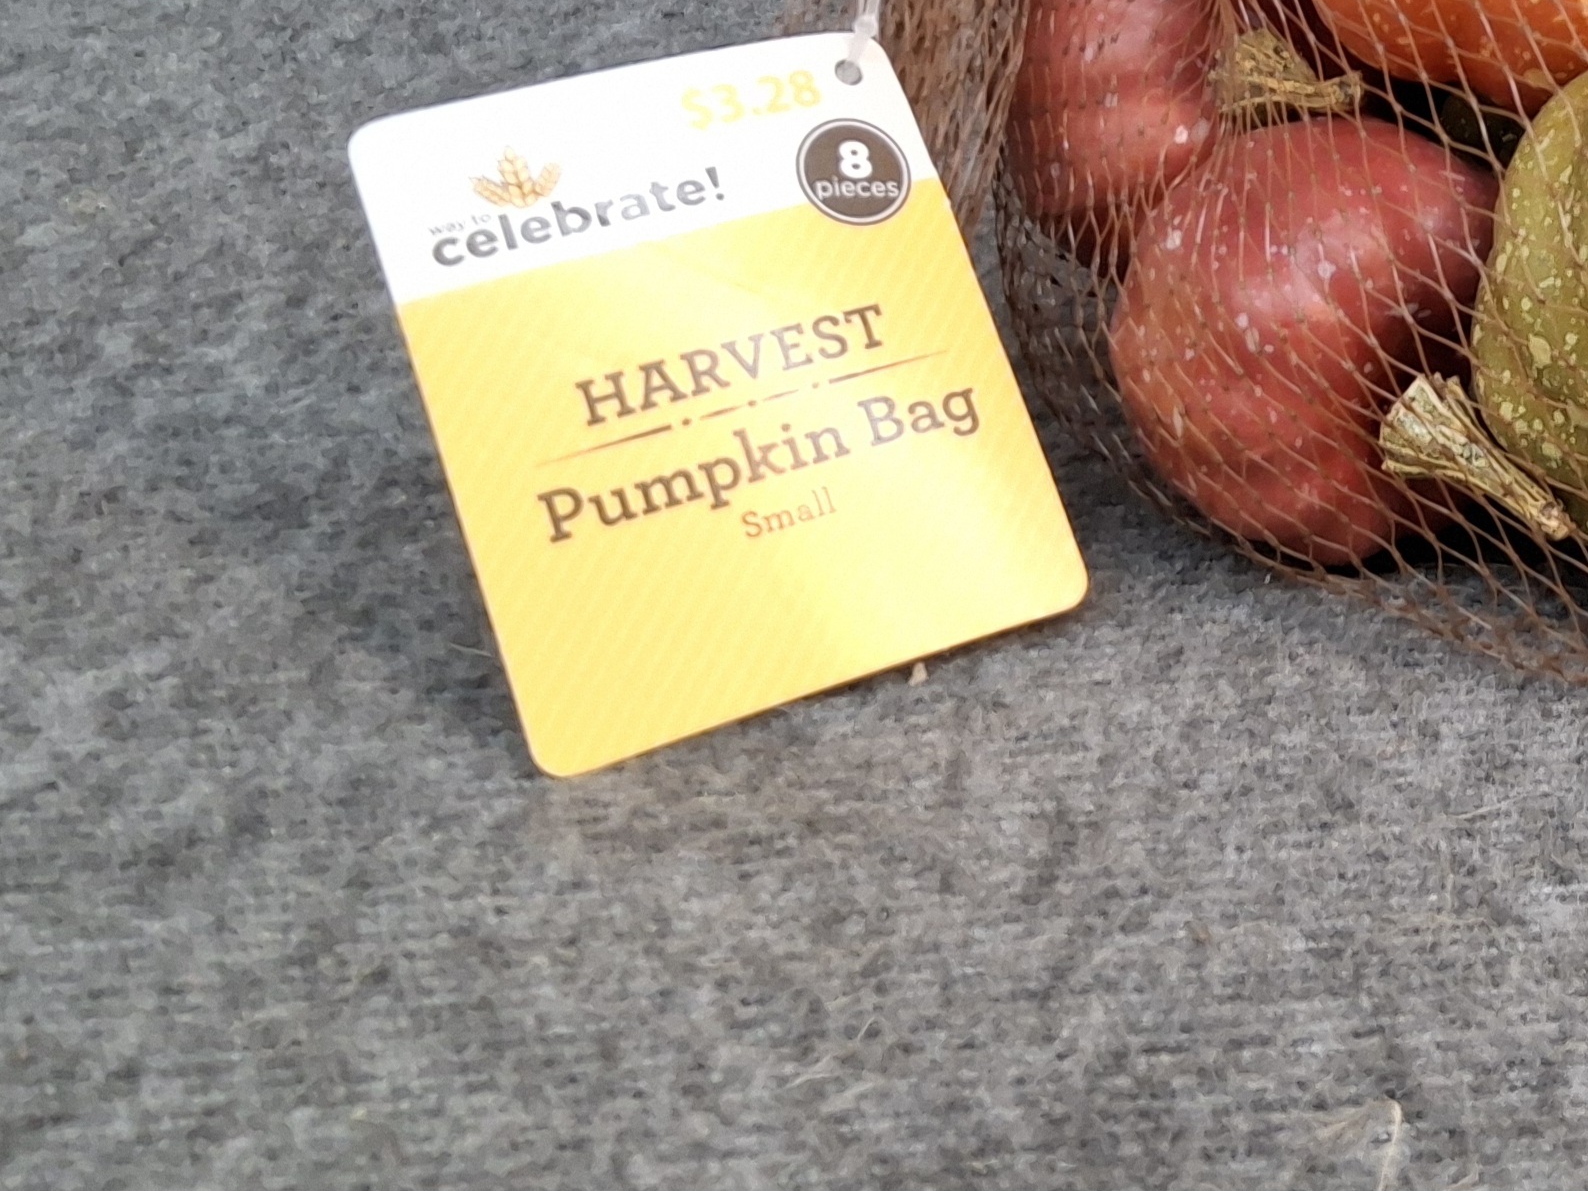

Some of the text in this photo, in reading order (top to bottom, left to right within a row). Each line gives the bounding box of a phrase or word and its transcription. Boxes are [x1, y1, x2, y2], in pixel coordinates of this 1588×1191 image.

[681, 70, 822, 130] $3.28
[813, 175, 900, 201] pieces
[838, 139, 873, 179] 8
[432, 166, 726, 267] celebrate!
[575, 304, 883, 427] HARVEST
[537, 387, 980, 543] Pumpkin Bag
[741, 486, 838, 538] Small
